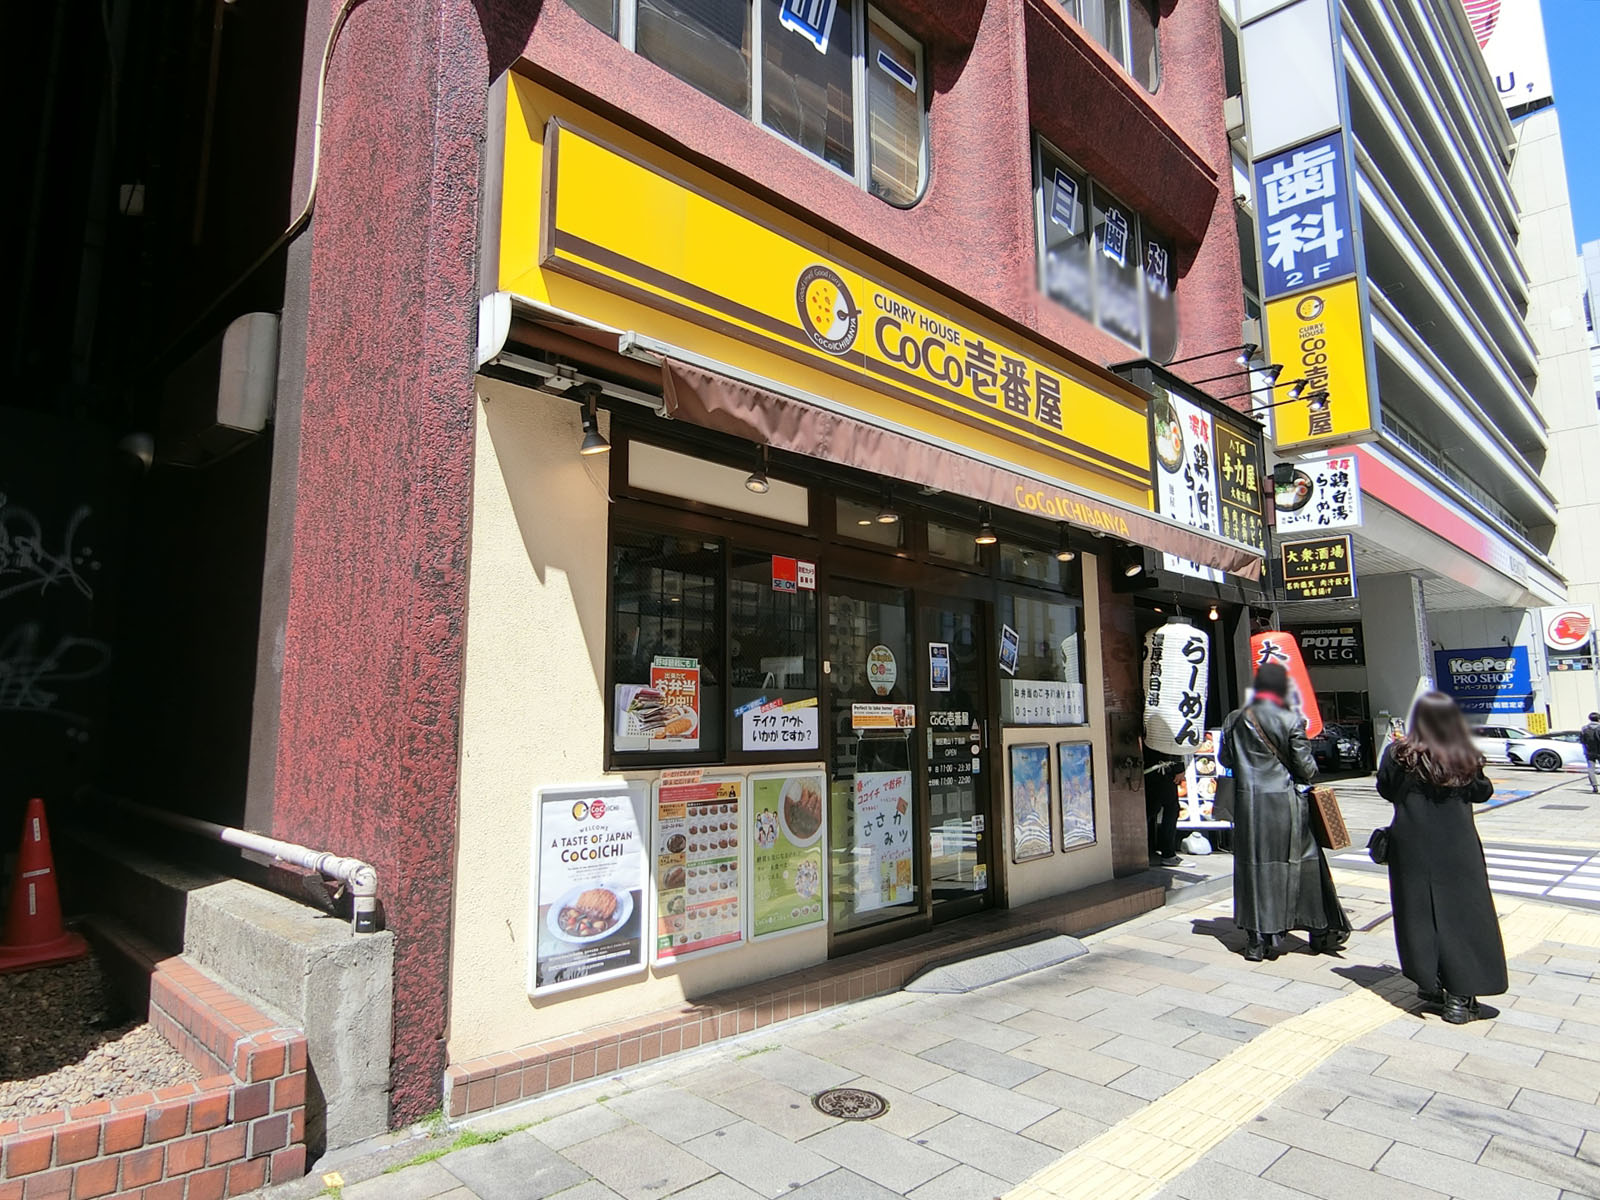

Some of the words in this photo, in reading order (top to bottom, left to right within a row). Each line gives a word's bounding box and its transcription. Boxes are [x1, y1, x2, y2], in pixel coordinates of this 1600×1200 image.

[1262, 145, 1344, 272] 歯科
[874, 293, 916, 325] CURRY
[919, 314, 961, 347] HOUSE
[1299, 323, 1325, 334] CURRY
[1299, 328, 1325, 340] HOUSE
[875, 316, 1063, 431] CoCo壱番屋
[1222, 452, 1258, 492] 与力屋
[1316, 473, 1331, 525] らーめん
[1330, 471, 1348, 520] 鶏白湯
[1015, 485, 1130, 537] CoCoICHIBANYA
[1286, 544, 1345, 563] 大衆酒場
[774, 579, 795, 589] SEOM
[1449, 657, 1516, 674] KeePer
[1453, 674, 1478, 684] PRO
[1480, 673, 1514, 683] SHOP
[655, 679, 696, 696] お弁当
[1175, 636, 1205, 746] らーめん
[753, 716, 777, 727] テイク
[781, 716, 803, 727] アウト
[753, 730, 778, 742] いかが
[944, 748, 958, 757] OPEN
[579, 825, 609, 833] WELCOME
[552, 839, 558, 848] A
[561, 835, 588, 847] TASTE
[591, 833, 603, 844] OF
[605, 831, 633, 843] JAPAN
[561, 844, 624, 863] CoCoICHI
